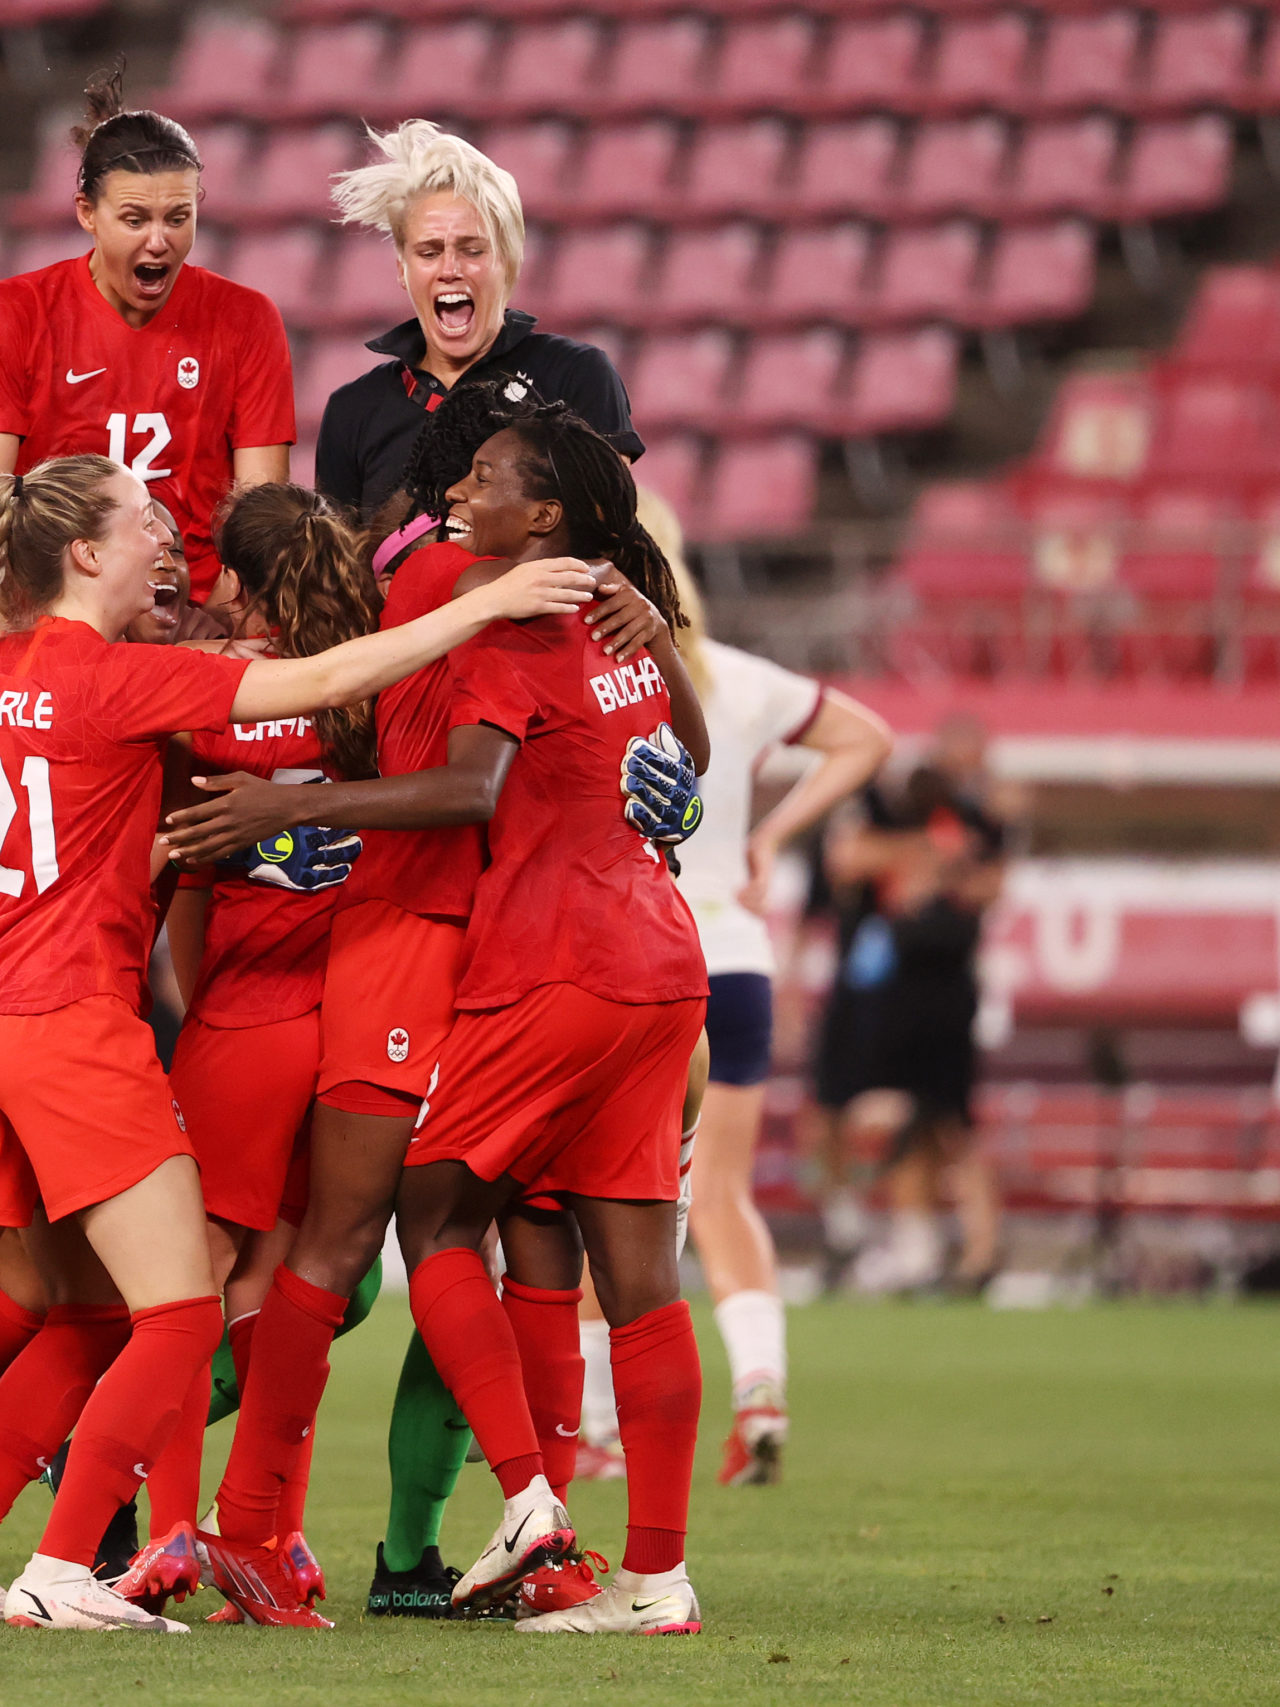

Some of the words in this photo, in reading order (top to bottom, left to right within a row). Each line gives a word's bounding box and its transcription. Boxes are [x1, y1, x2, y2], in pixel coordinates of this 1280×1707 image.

[105, 412, 172, 481] 12
[589, 656, 670, 715] BUCHA
[392, 1589, 451, 1606] balanc
